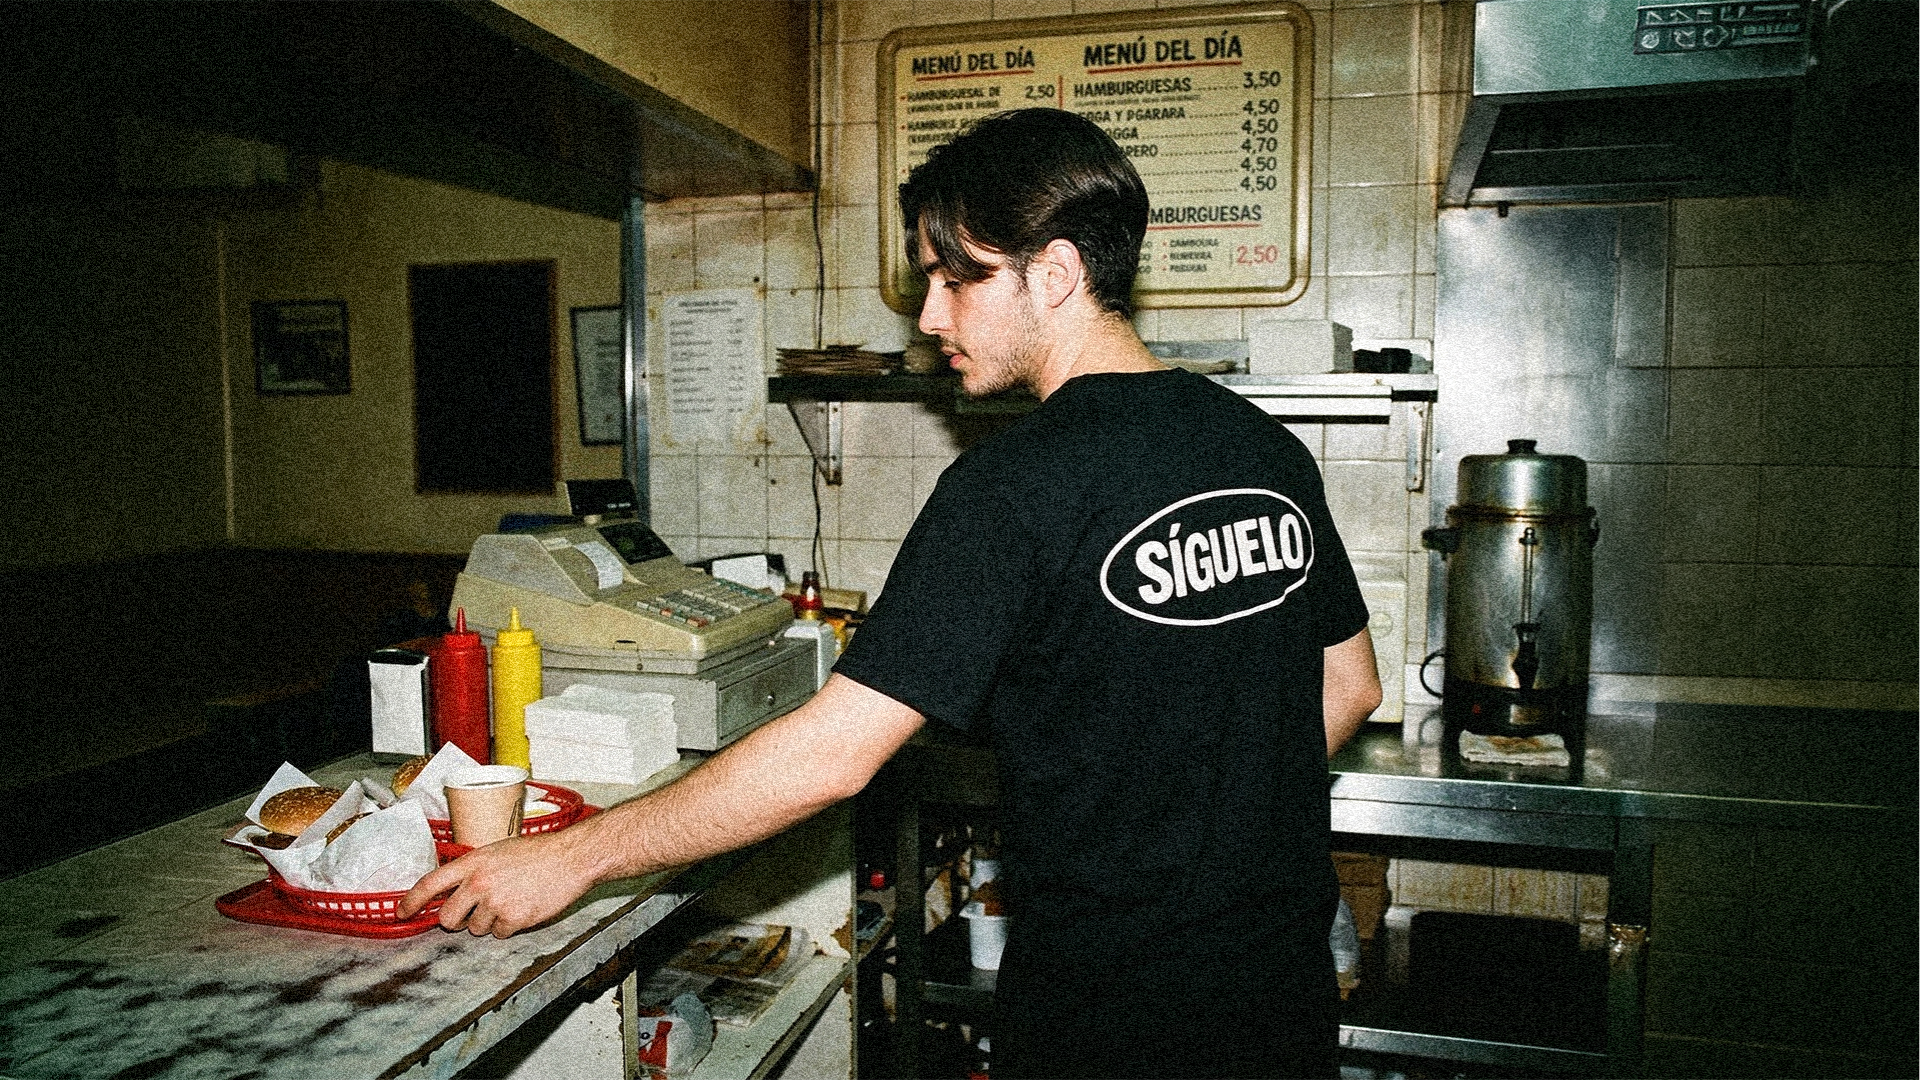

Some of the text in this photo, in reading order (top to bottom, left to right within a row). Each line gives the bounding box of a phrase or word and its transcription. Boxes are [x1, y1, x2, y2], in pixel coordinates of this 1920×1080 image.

[1083, 30, 1243, 67] MENÚ DEL DÍA
[912, 45, 1035, 74] MENÚ DEL DÍA
[1024, 84, 1055, 100] 2,50
[1074, 71, 1281, 98] HAMBURGUESAS 3,50
[1115, 110, 1123, 122] Y
[1242, 99, 1280, 117] 4,50
[1241, 117, 1279, 136] 4,50
[1241, 137, 1278, 155] 4,70
[1240, 156, 1277, 174] 4,50
[1240, 175, 1277, 193] 4,50
[1149, 204, 1262, 224] MBURGUESAS
[1236, 245, 1279, 266] 2,50
[1135, 513, 1304, 605] SÍGUELO
